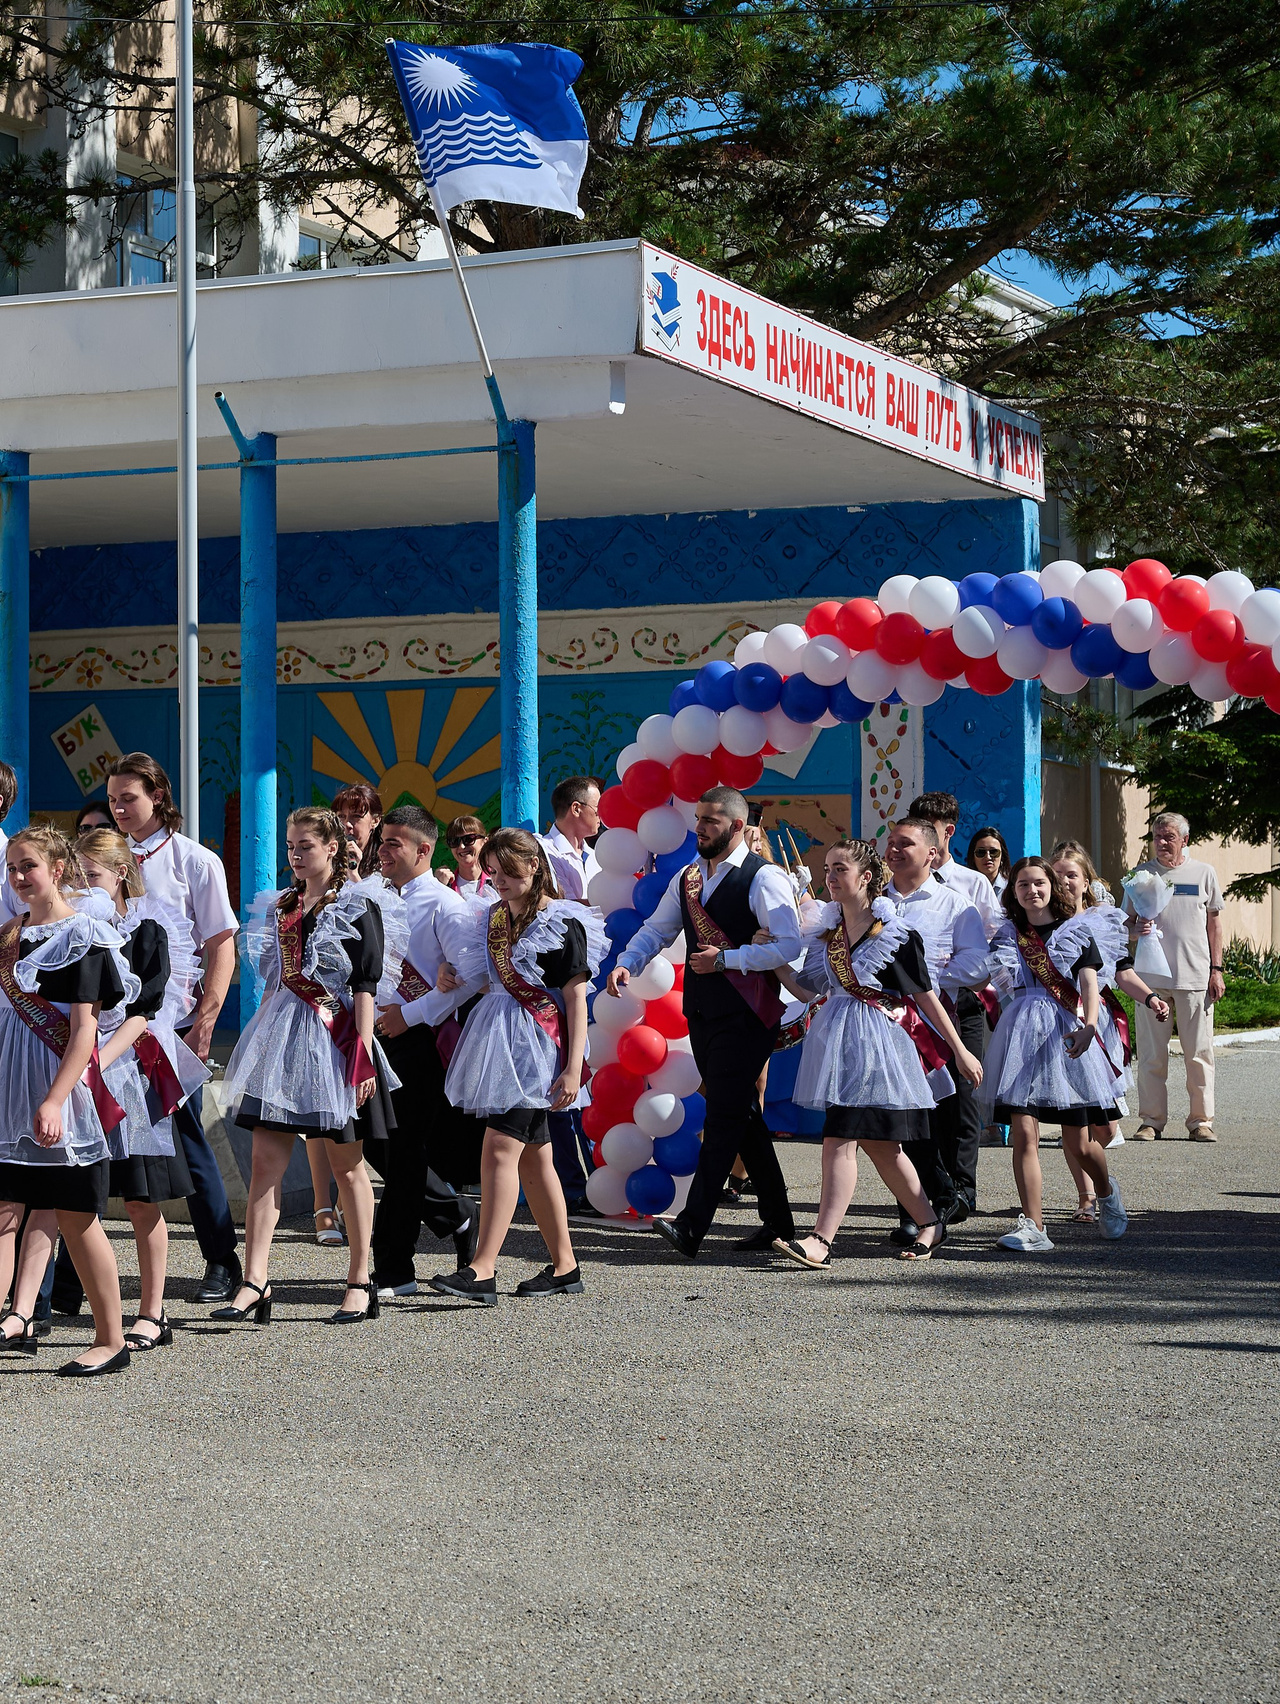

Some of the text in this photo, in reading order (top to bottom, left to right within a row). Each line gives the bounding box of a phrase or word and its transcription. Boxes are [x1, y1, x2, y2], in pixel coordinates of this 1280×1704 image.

[696, 288, 1042, 484] ЗДЕСЬ НАЧИНАЕТСЯ ВАШ ПУТЬ К УСПЕХУ!
[401, 975, 429, 1000] 2024
